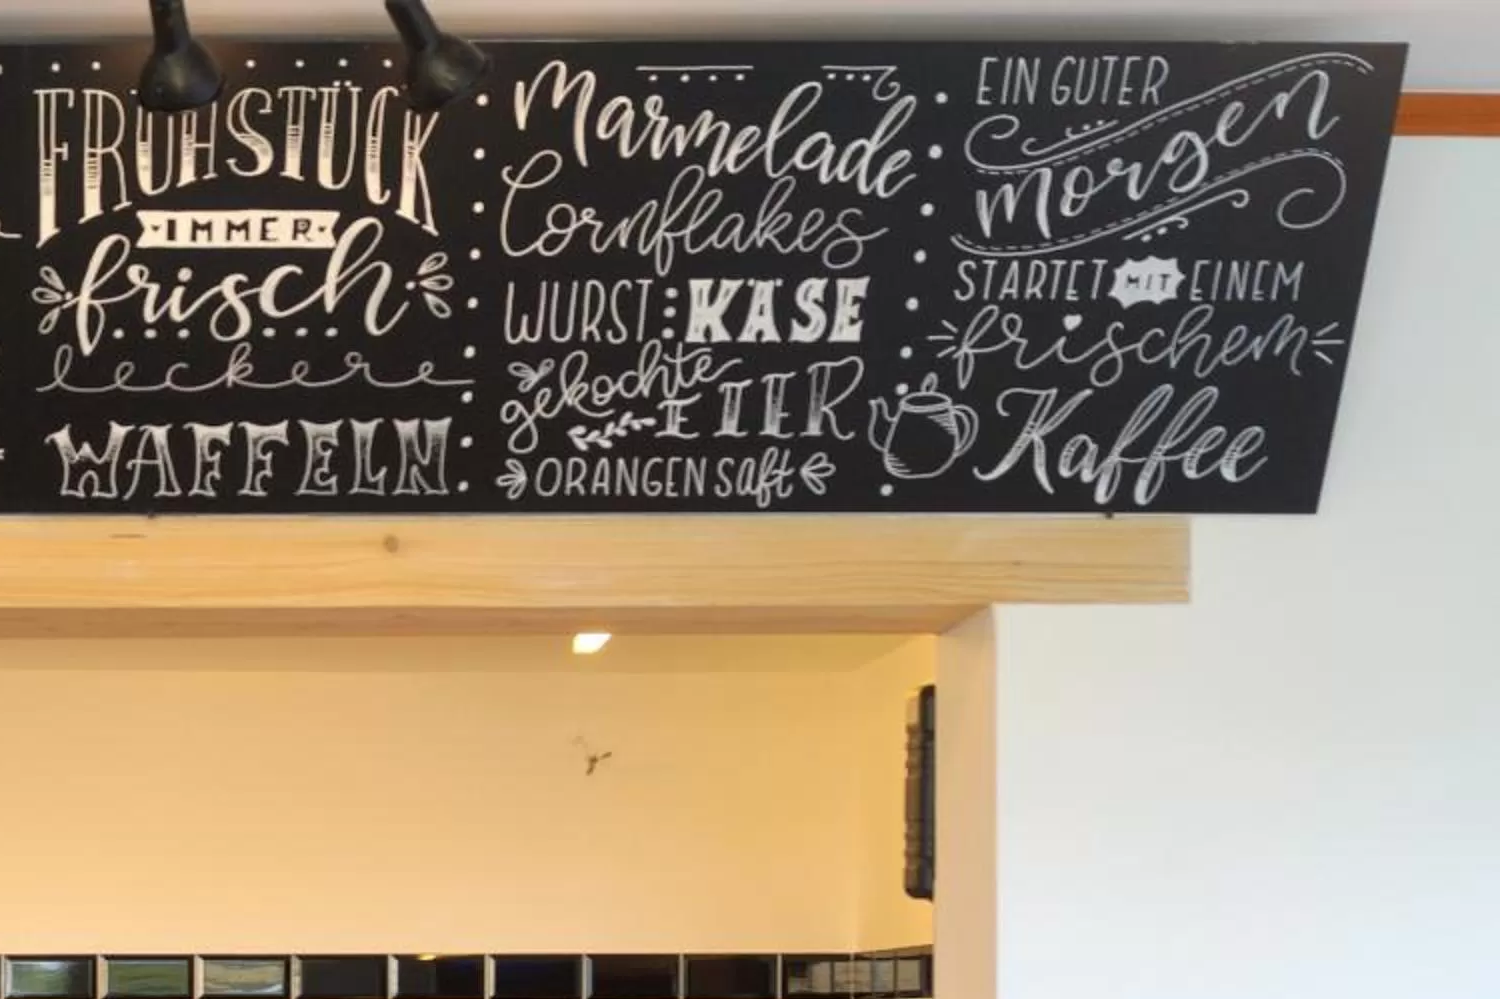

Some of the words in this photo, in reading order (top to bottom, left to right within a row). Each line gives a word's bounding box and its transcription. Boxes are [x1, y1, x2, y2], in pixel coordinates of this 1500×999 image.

[976, 56, 1041, 105] EIN
[1051, 55, 1169, 105] GUTER
[513, 60, 917, 198] Marmelade
[165, 217, 314, 243] IMMER
[501, 150, 889, 276] Cornflakes
[62, 216, 410, 357] frisch
[505, 279, 653, 344] WURST
[685, 276, 871, 343] KÄSE
[953, 259, 1108, 301] STARTET
[1124, 272, 1173, 292] MIT
[1190, 260, 1304, 301] EINEM
[36, 343, 475, 393] leckere
[952, 304, 1303, 390] frischem
[500, 340, 744, 454] gekochte
[654, 356, 865, 440] EIER
[44, 417, 453, 500] WAFFELN
[973, 383, 1269, 505] Kaffee
